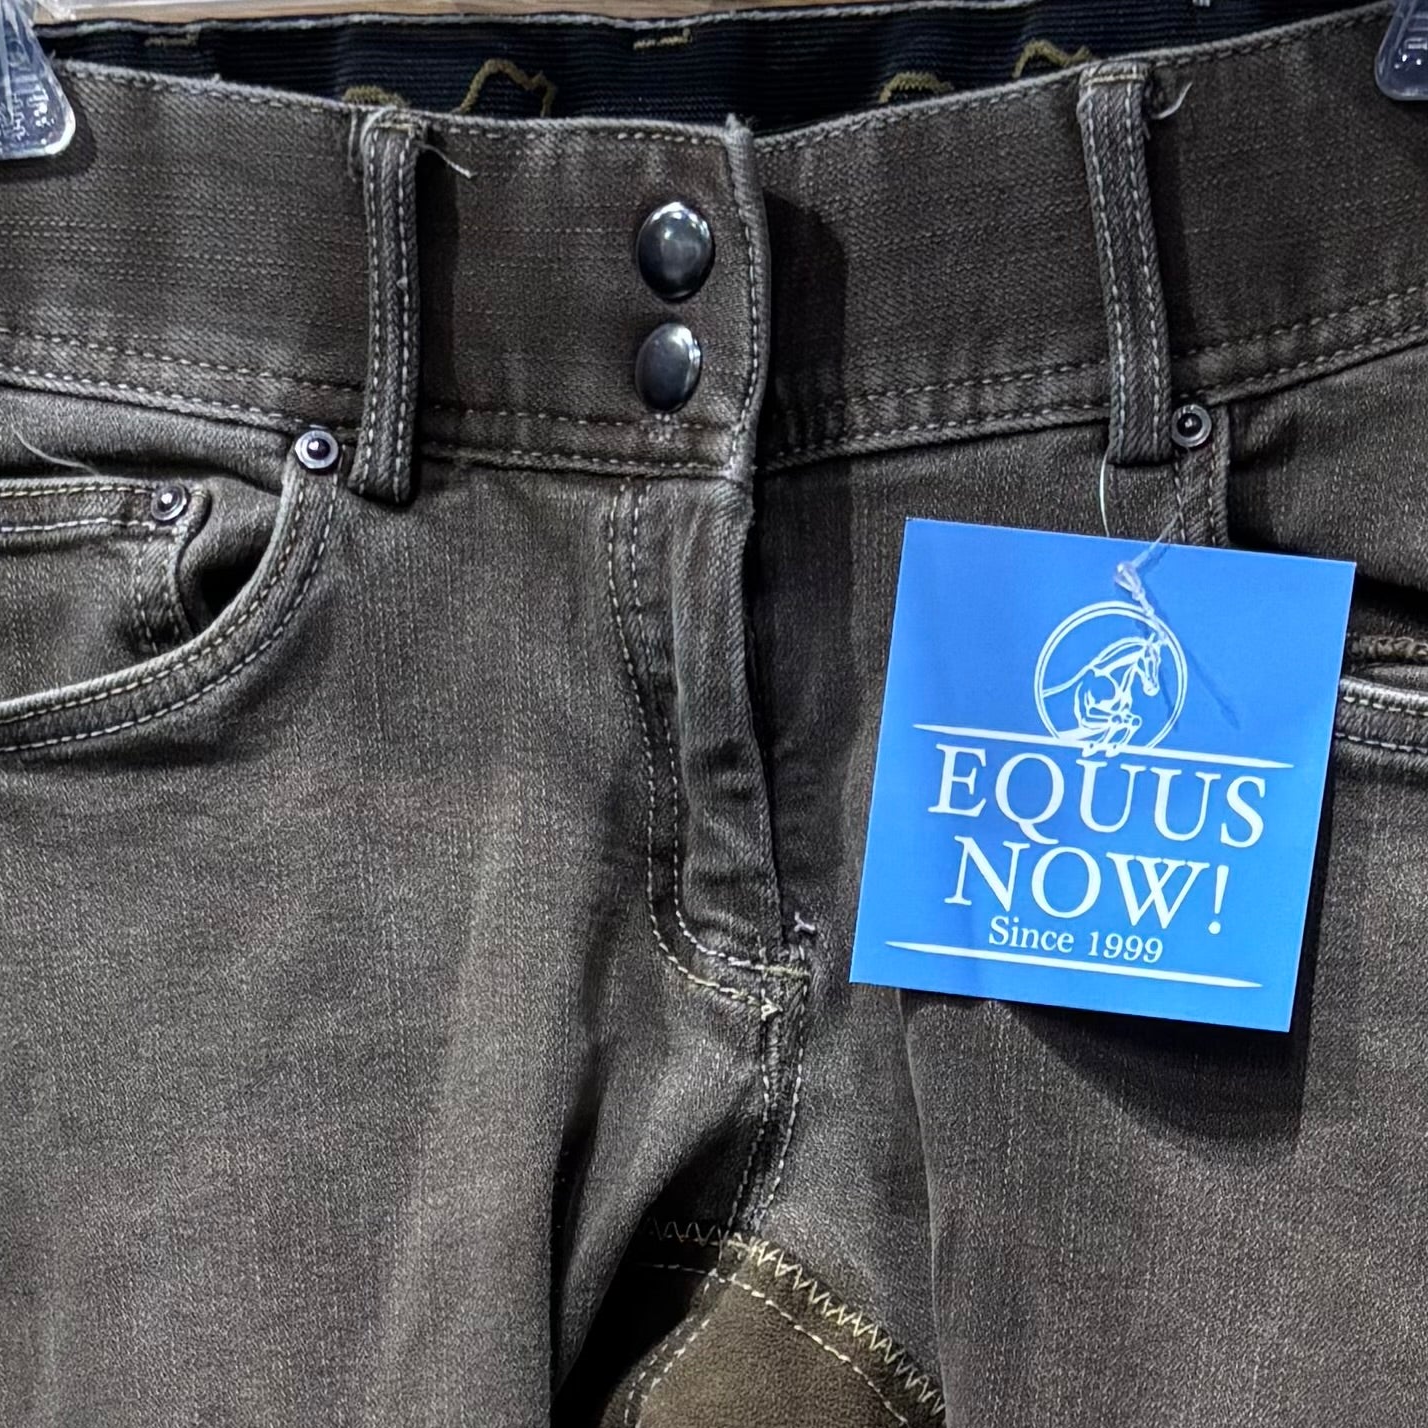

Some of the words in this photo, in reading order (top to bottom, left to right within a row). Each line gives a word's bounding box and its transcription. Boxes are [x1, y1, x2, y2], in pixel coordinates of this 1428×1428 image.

[927, 742, 1267, 849] EQUUS
[943, 834, 1231, 936] NOW!
[987, 915, 1075, 954] Since
[1087, 931, 1164, 964] 1999
